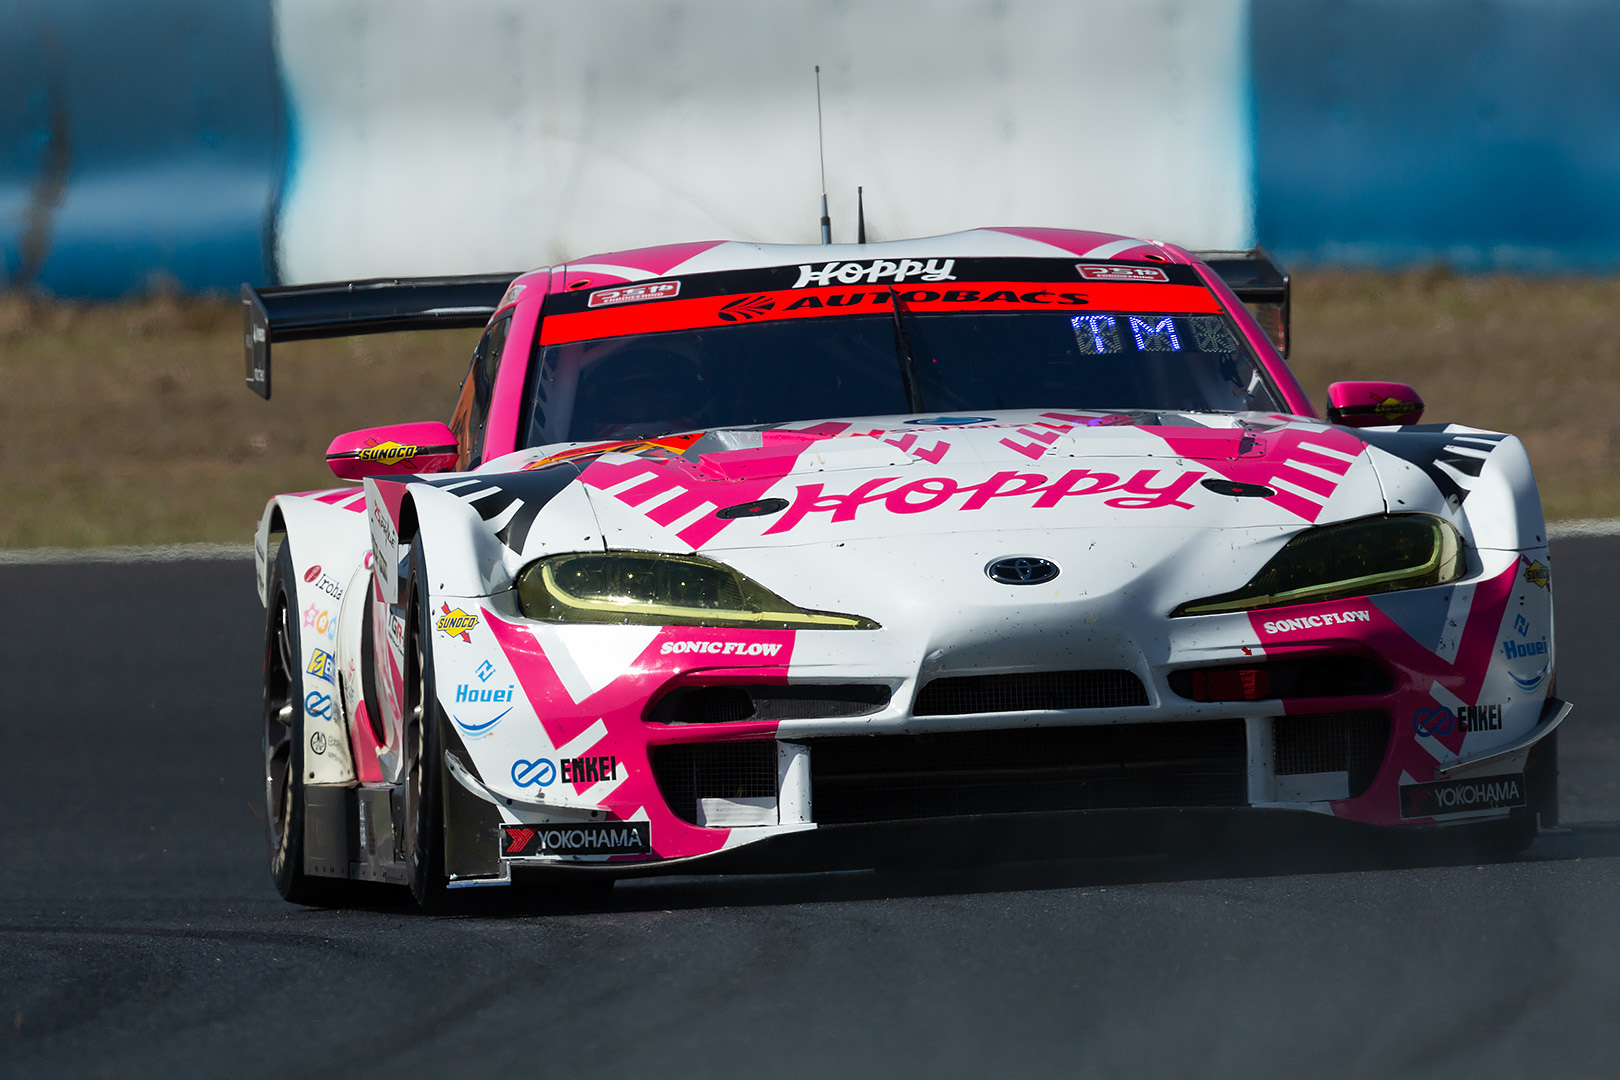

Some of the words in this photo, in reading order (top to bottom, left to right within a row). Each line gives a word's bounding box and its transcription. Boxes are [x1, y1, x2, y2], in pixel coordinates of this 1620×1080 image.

[783, 289, 1089, 311] AUTOBACS
[361, 446, 416, 460] SUNOCO
[761, 468, 1207, 537] Hoppy
[315, 573, 343, 600] Iroha
[437, 614, 478, 631] SUNOCO
[1263, 615, 1324, 634] SONIC
[1324, 610, 1370, 626] FLOW
[660, 641, 722, 655] SONIC
[722, 642, 782, 657] FLOW
[1503, 636, 1548, 660] Houei
[456, 684, 515, 703] Houei
[1457, 703, 1503, 733] ENKEI
[560, 755, 617, 784] ENKEI
[1434, 780, 1520, 808] YOKOHAMA
[537, 828, 643, 850] YOKOHAMA
